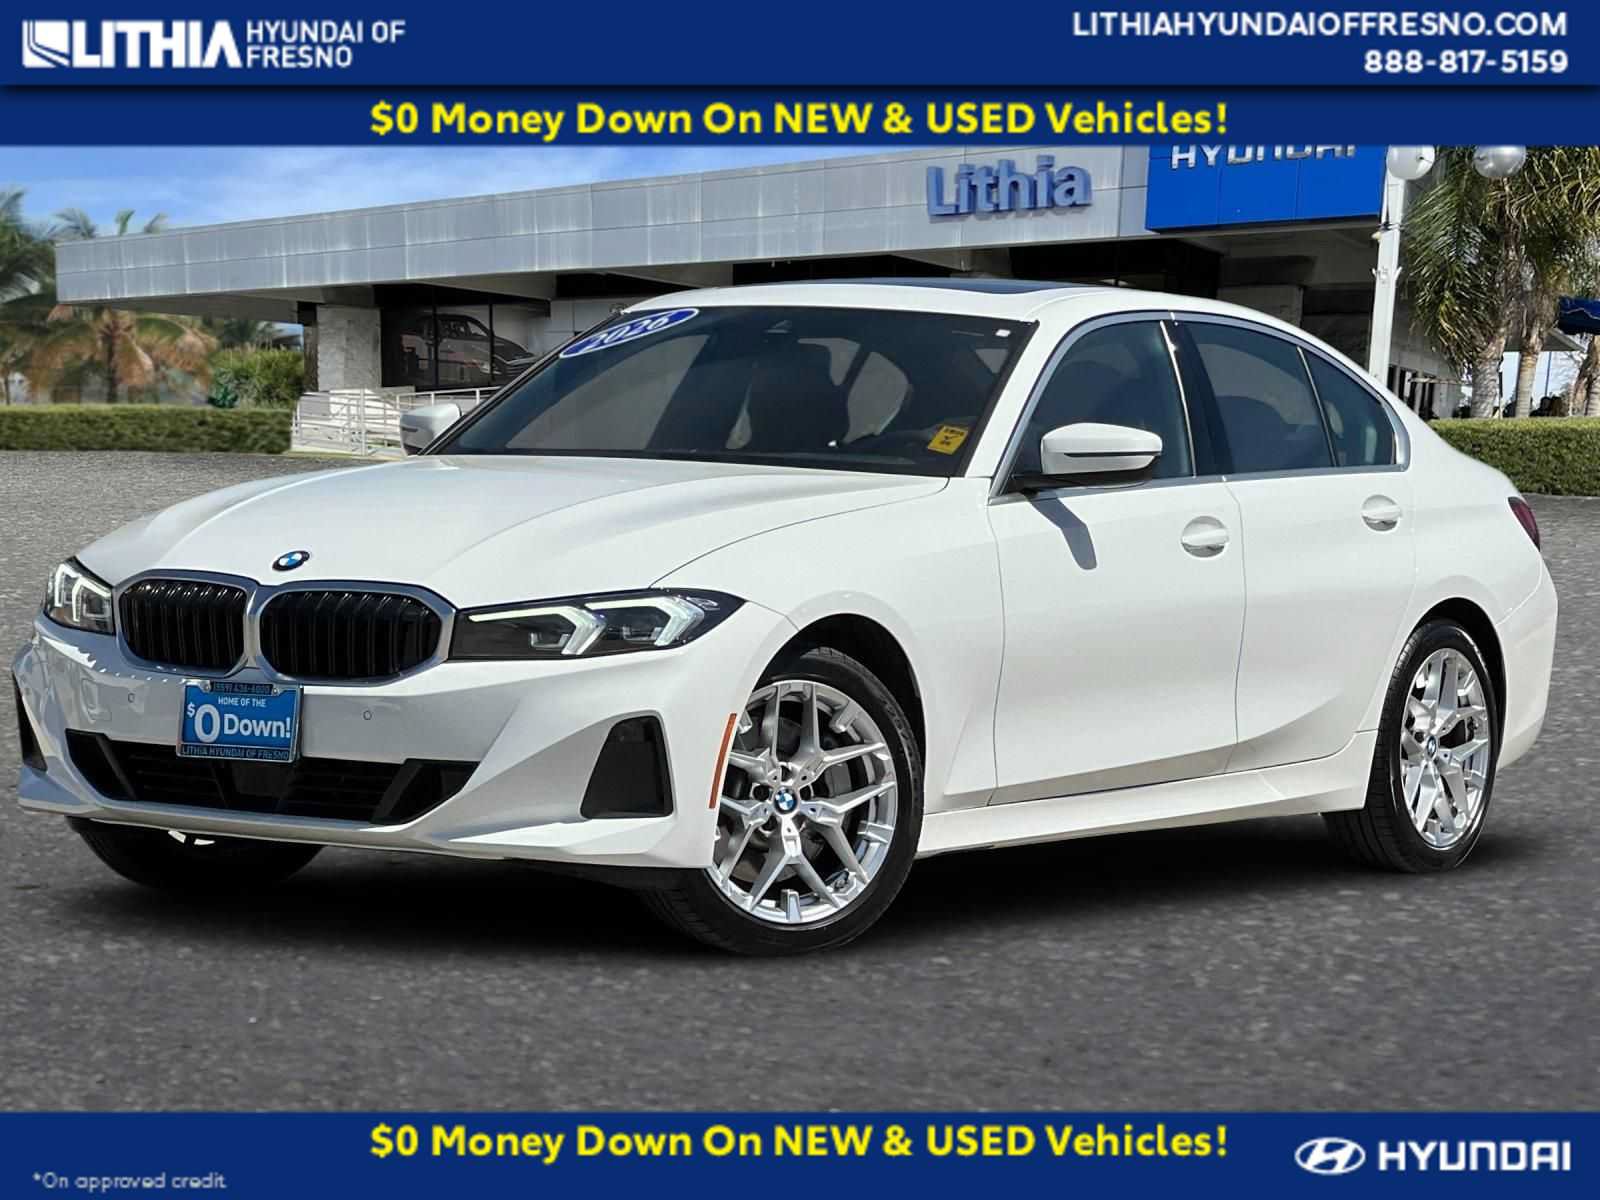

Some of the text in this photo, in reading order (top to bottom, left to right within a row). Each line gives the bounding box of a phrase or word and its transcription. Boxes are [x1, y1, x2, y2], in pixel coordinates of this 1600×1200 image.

[926, 154, 1092, 217] Lithia
[218, 696, 267, 708] HOME OF THE
[223, 713, 292, 739] Down!
